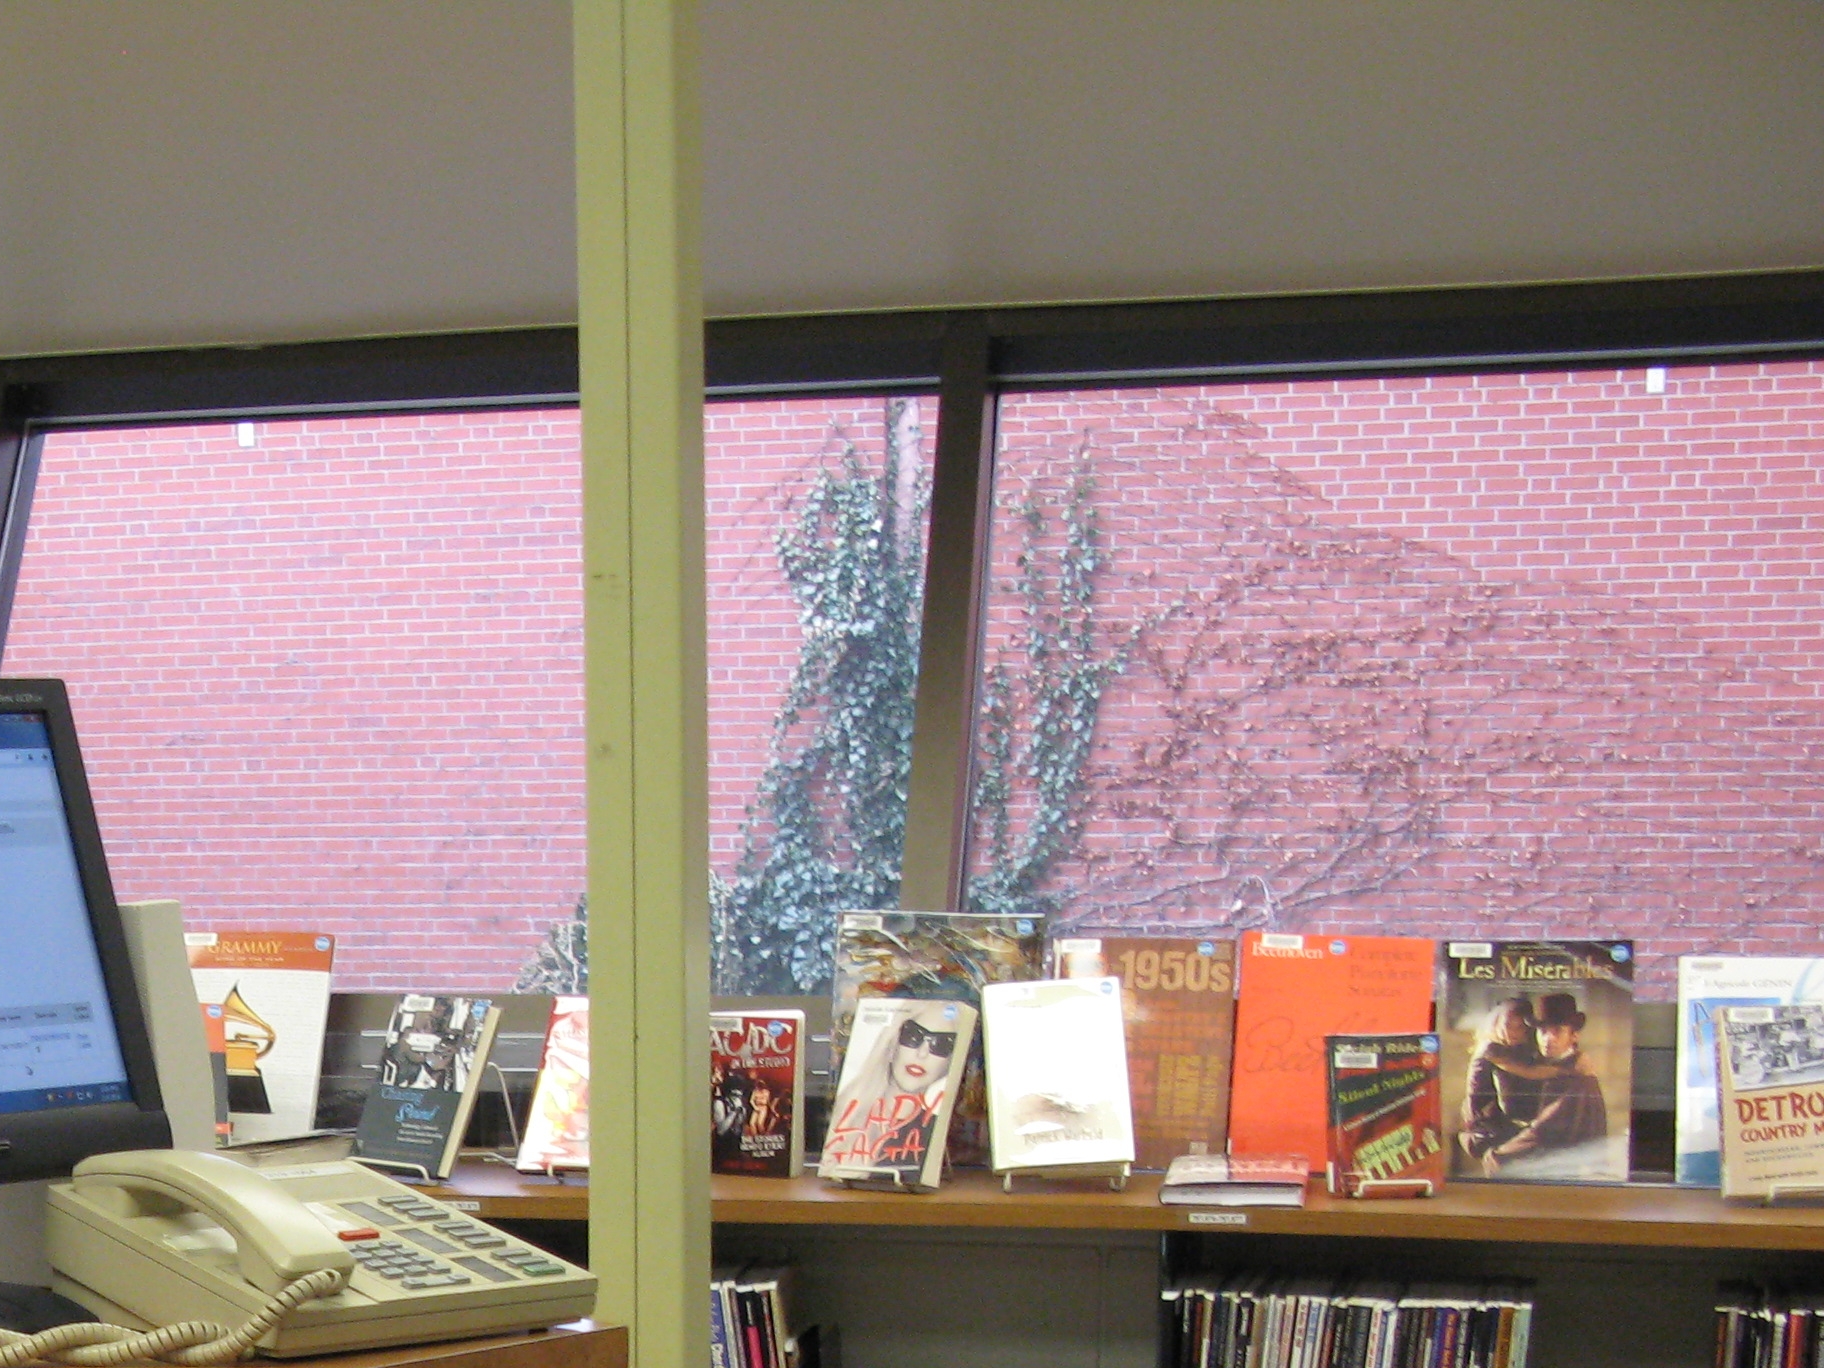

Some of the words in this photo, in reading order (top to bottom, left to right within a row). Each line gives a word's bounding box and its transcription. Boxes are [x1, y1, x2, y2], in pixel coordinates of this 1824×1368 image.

[207, 940, 283, 954] GRAMMY
[1458, 957, 1496, 979] Les
[1501, 954, 1615, 980] Misérables
[833, 1090, 946, 1134] LADY
[1740, 1122, 1808, 1144] COUNTRY
[823, 1127, 926, 1166] GAGA
